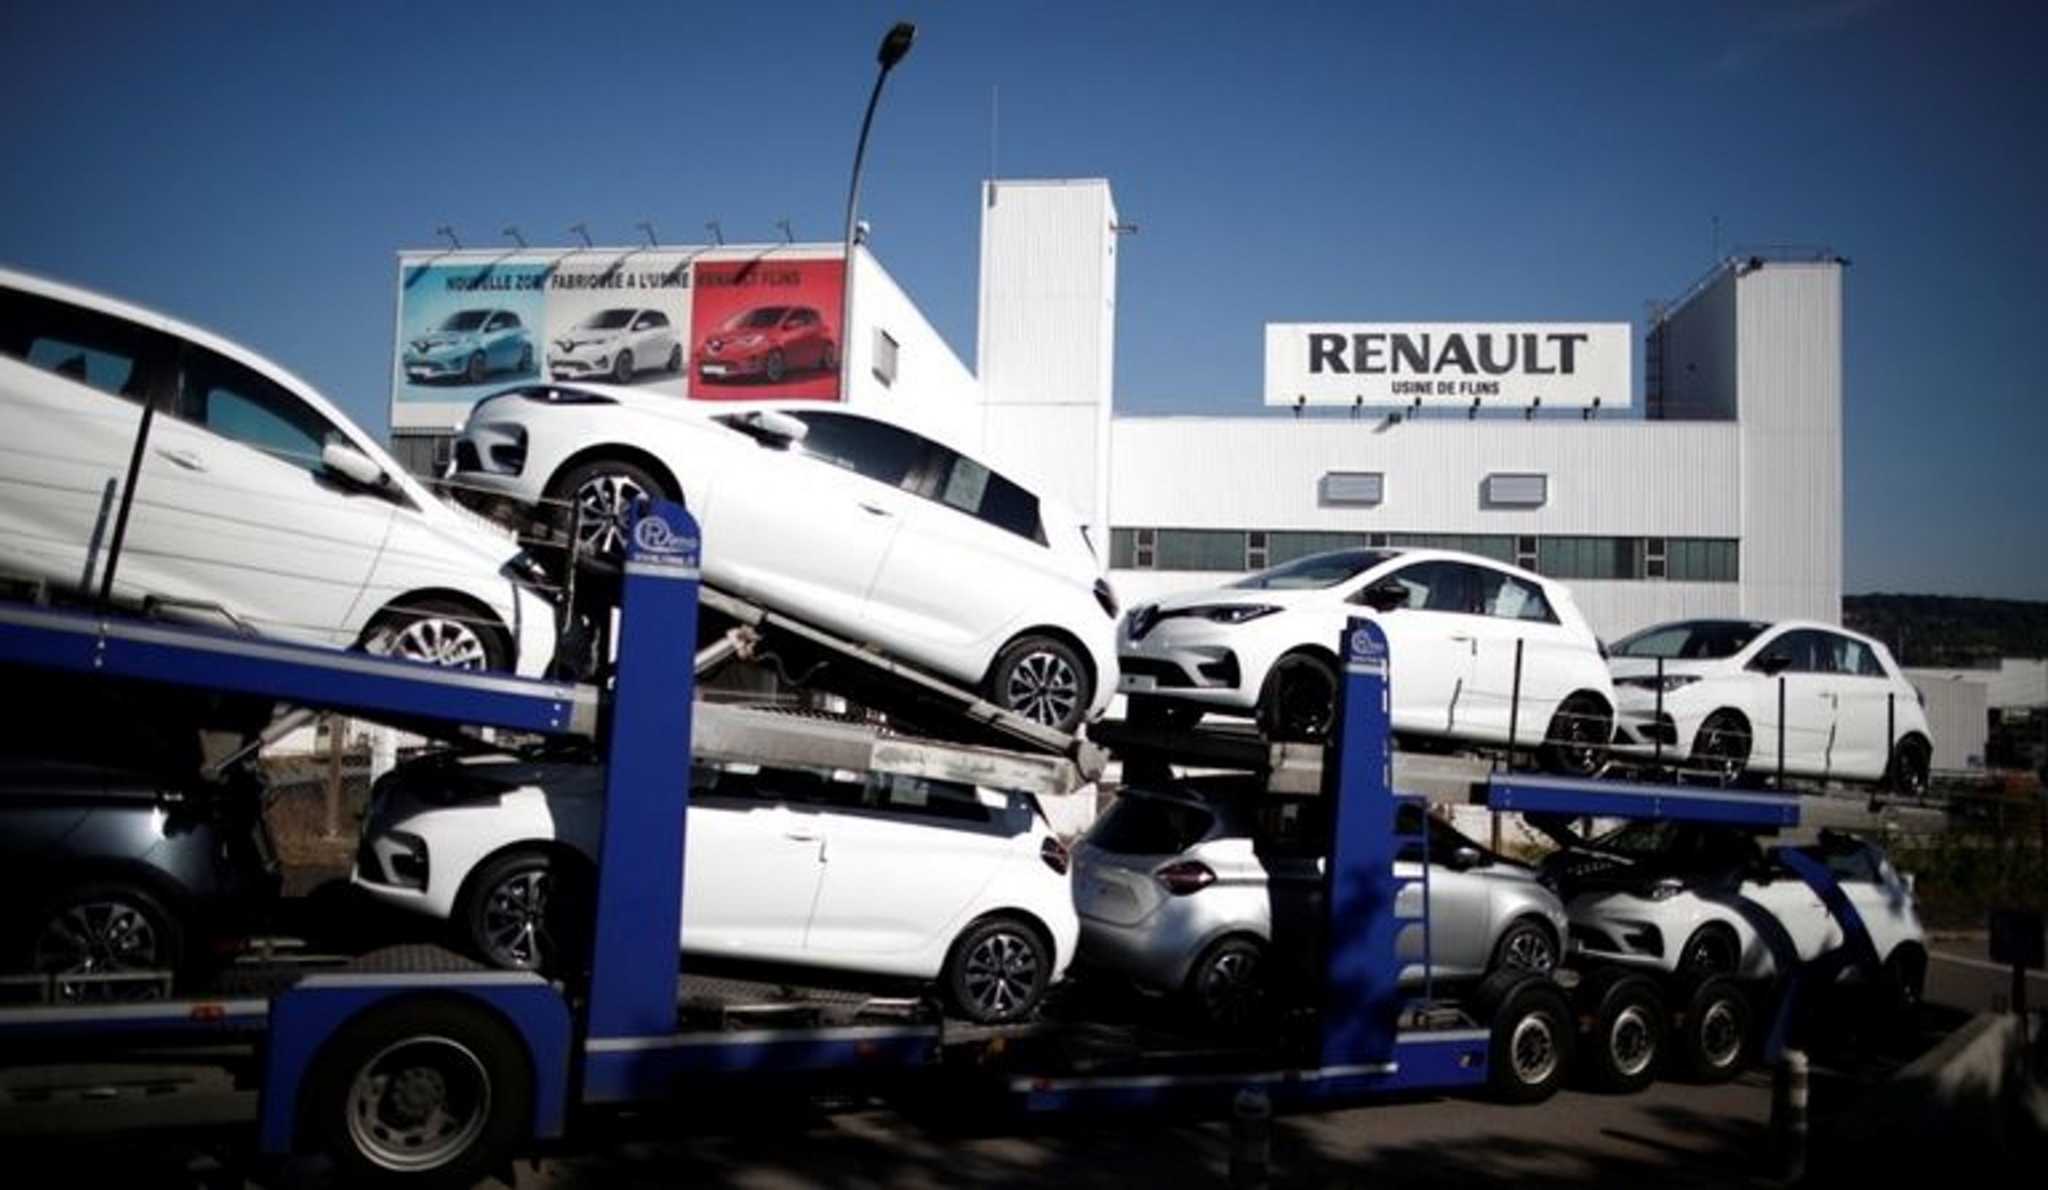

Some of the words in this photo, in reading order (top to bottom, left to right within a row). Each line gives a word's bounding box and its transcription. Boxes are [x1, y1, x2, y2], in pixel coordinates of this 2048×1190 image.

[1308, 333, 1588, 374] RENAULT
[1391, 381, 1433, 395] USINE
[1437, 381, 1456, 395] DE
[1459, 381, 1500, 396] FLINS
